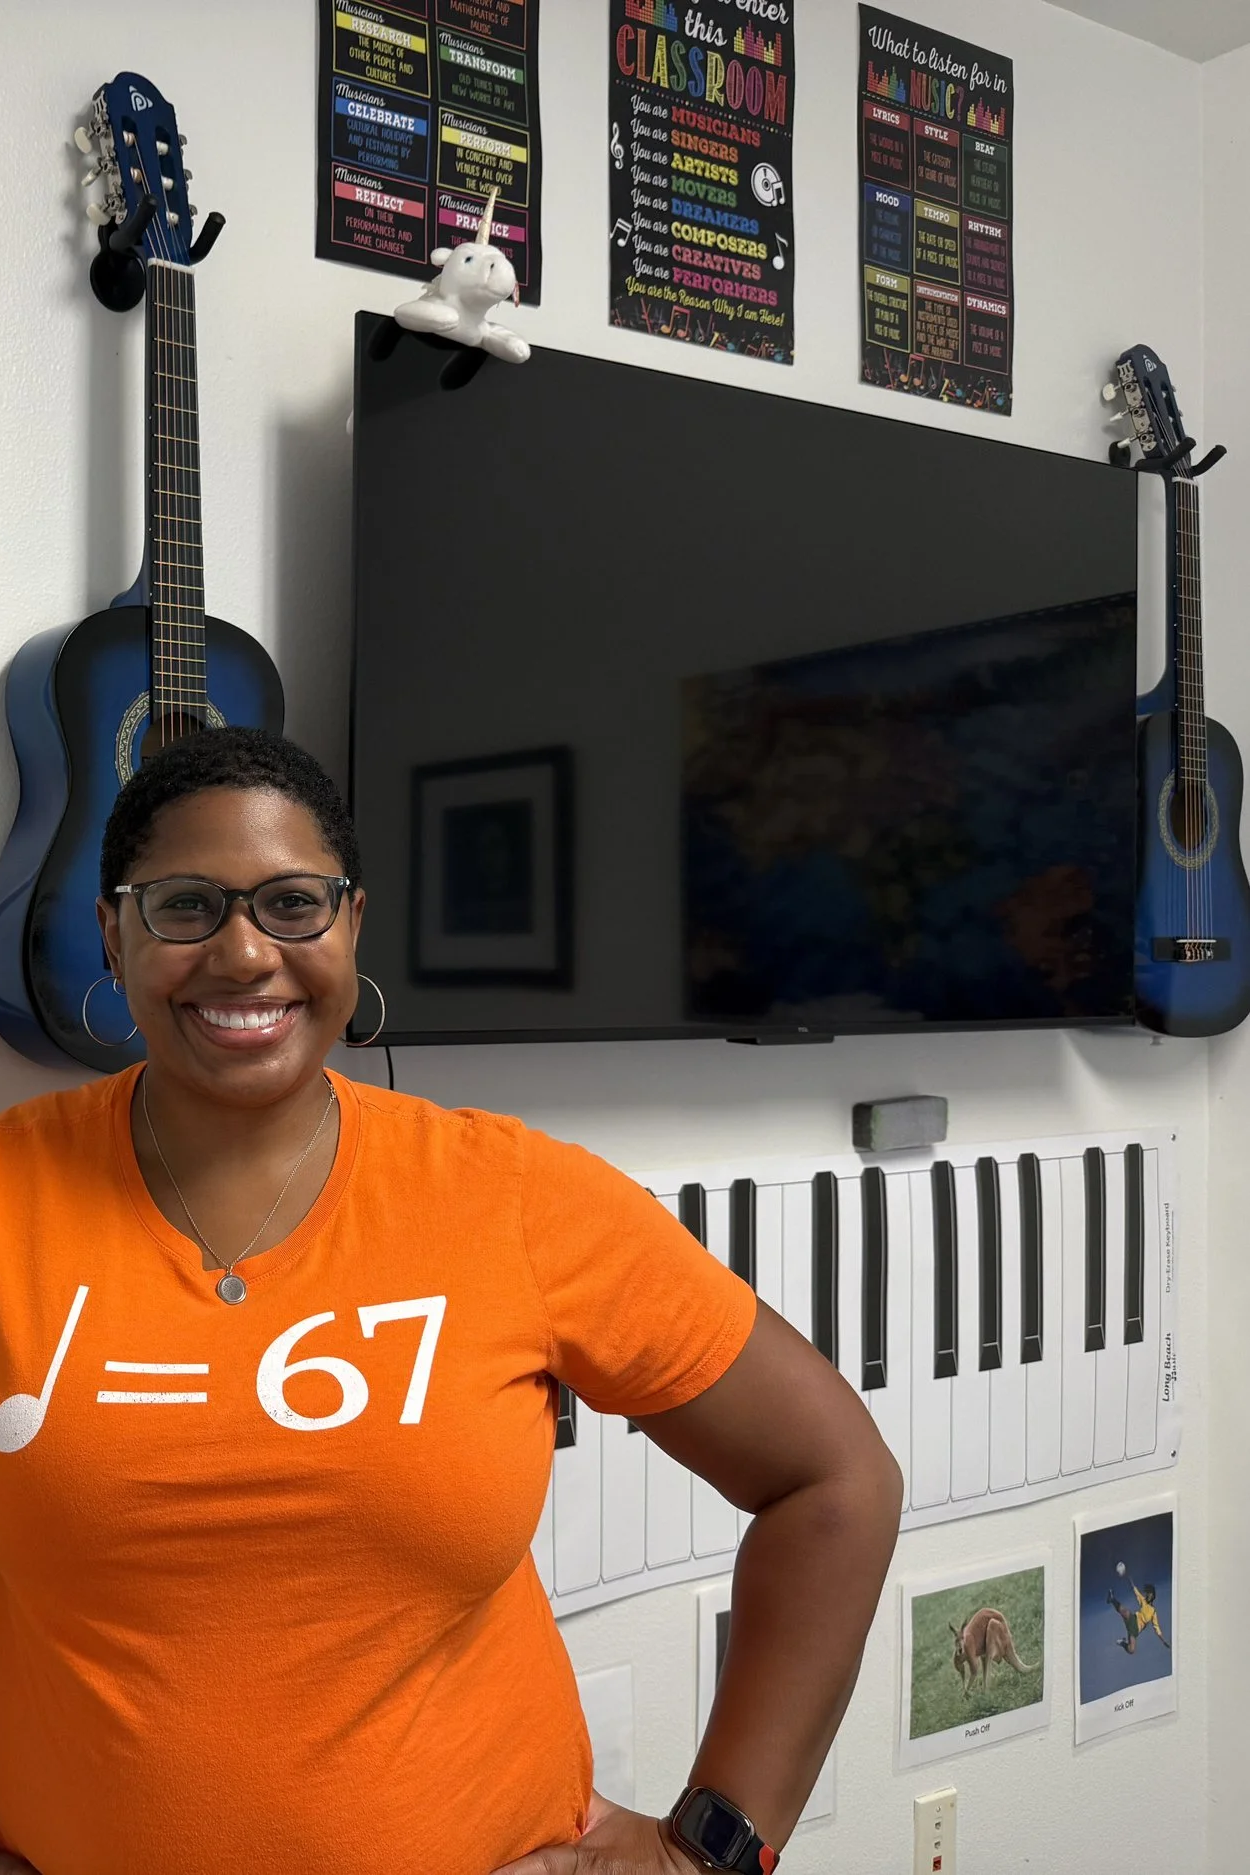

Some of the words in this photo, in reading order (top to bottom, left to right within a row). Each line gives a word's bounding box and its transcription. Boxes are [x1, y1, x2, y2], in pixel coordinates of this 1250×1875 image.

[336, 0, 385, 23] Musicians
[450, 0, 498, 24] MATHEMATICS
[500, 15, 509, 27] OF
[496, 1, 510, 14] AND
[351, 18, 411, 48] RESEARCH
[470, 20, 491, 33] MUSIC
[684, 9, 728, 47] this
[359, 35, 370, 49] THE
[373, 40, 394, 56] MUSIC
[396, 48, 405, 59] OF
[439, 32, 486, 56] Musicians
[349, 47, 370, 63] OTHER
[373, 55, 396, 71] PEOPLE
[399, 64, 414, 75] AND
[448, 49, 517, 81] TRANSFORM
[868, 25, 910, 60] What
[912, 41, 928, 65] to
[928, 48, 969, 80] listen
[969, 62, 992, 91] for
[993, 74, 1008, 94] in
[365, 65, 397, 84] CULTURES
[616, 24, 787, 125] CLASSROOM
[336, 82, 386, 107] Musicians
[909, 69, 965, 122] MUSIC?
[347, 102, 415, 132] CELEBRATE
[442, 112, 488, 135] Musicians
[630, 94, 651, 114] You
[652, 106, 668, 119] are
[671, 106, 761, 147] MUSICIANS
[872, 107, 900, 125] LYRICS
[346, 118, 378, 137] CULTURAL
[381, 127, 414, 146] HOLIDAYS
[459, 131, 511, 158] PERFORM
[630, 118, 651, 138] You
[652, 130, 668, 142] are
[671, 129, 739, 163] SINGERS
[924, 125, 949, 141] STYLE
[348, 134, 364, 147] AND
[366, 138, 399, 156] FESTIVALS
[400, 147, 411, 159] BY
[975, 141, 995, 156] BEAT
[357, 150, 399, 170] PERFORMING
[456, 147, 464, 158] IN
[465, 149, 498, 168] CONCERTS
[499, 158, 514, 172] AND
[630, 141, 651, 162] You
[652, 153, 668, 165] are
[671, 152, 739, 186] ARTISTS
[335, 167, 384, 190] Musicians
[455, 161, 480, 177] VENUES
[481, 168, 493, 181] ALL
[495, 172, 513, 187] OVER
[466, 177, 477, 190] THE
[630, 164, 651, 185] You
[652, 176, 668, 188] are
[671, 175, 738, 208] MOVERS
[355, 188, 404, 212] REFLECT
[439, 194, 484, 216] Musicians
[630, 187, 651, 208] You
[652, 199, 668, 212] are
[671, 198, 760, 235] DREAMERS
[876, 191, 900, 208] MOOD
[364, 207, 374, 218] ON
[377, 210, 393, 224] THEIR
[455, 213, 509, 238] PRAICE
[923, 206, 950, 223] TEMPO
[345, 216, 395, 238] PERFORMANCES
[398, 230, 413, 242] AND
[631, 211, 652, 231] You
[652, 222, 669, 234] are
[671, 221, 768, 260] COMPOSERS
[968, 220, 1002, 238] RHYTHM
[353, 232, 372, 246] MAKE
[375, 238, 404, 255] CHANGES
[632, 234, 652, 255] You
[653, 245, 669, 257] are
[672, 244, 762, 281] CREATIVES
[632, 256, 653, 278] You
[654, 267, 670, 280] are
[672, 266, 778, 306] PERFORMERS
[876, 274, 898, 288] FORM
[916, 285, 959, 302] INSTRUMENTATION
[625, 275, 647, 297] You
[647, 286, 663, 298] are
[663, 285, 678, 302] the
[679, 289, 711, 310] Reason
[712, 298, 736, 321] Why
[736, 306, 743, 318] I
[744, 310, 758, 321] am
[758, 309, 785, 327] Here!
[966, 297, 1006, 315] DYNAMICS
[255, 1294, 447, 1432] 67
[1163, 1333, 1171, 1369] Beach
[1162, 1373, 1172, 1402] Long
[1124, 1699, 1135, 1710] Off
[965, 1727, 980, 1738] Push
[980, 1723, 991, 1735] Off
